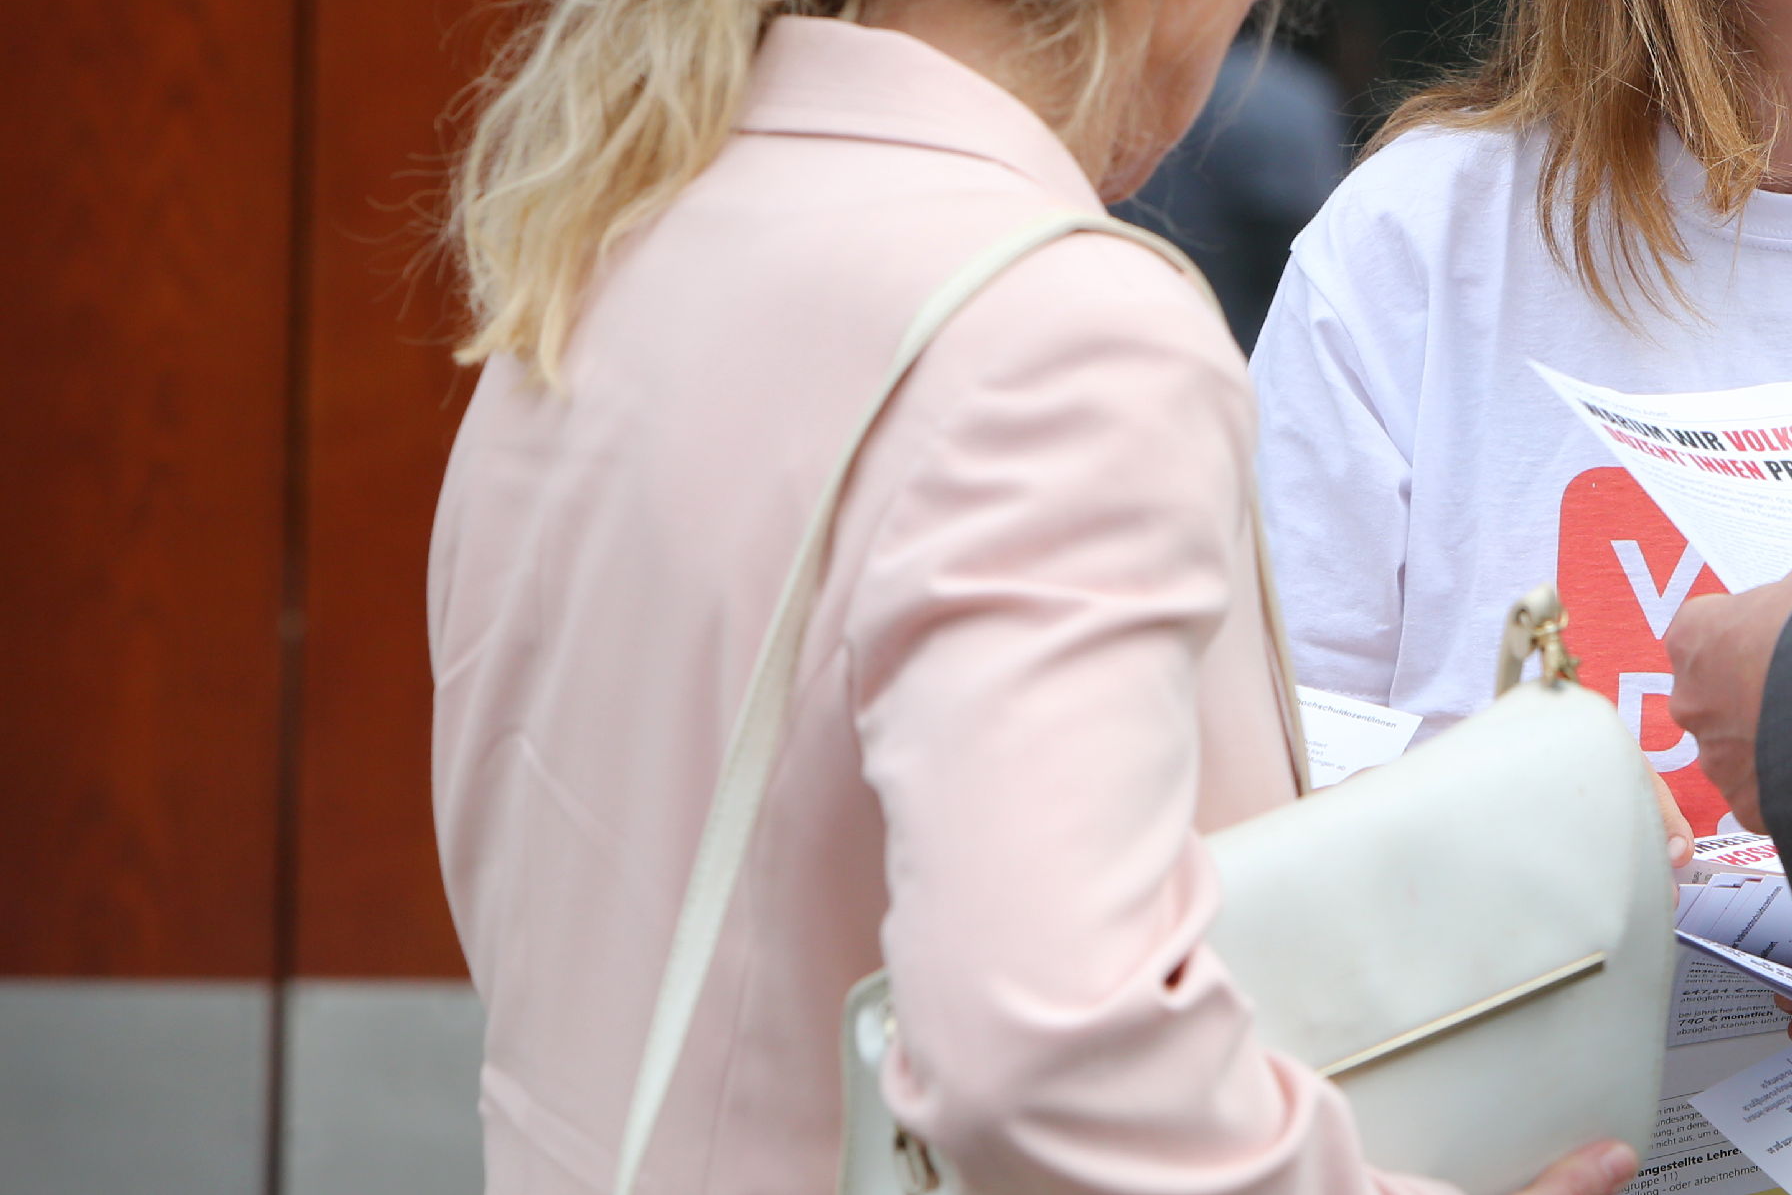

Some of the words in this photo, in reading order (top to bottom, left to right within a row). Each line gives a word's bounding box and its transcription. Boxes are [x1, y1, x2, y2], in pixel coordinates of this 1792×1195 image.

[1665, 428, 1728, 452] WIR
[1610, 540, 1707, 641] V
[1678, 1016, 1704, 1027] 790
[1708, 1015, 1719, 1023] €
[1720, 1010, 1774, 1022] monatlich
[1761, 1016, 1778, 1025] und
[1663, 1105, 1675, 1115] im
[1676, 1125, 1685, 1133] in
[1656, 1137, 1677, 1150] nicht
[1697, 1130, 1712, 1140] um
[1637, 1155, 1704, 1178] angestellte
[1662, 1170, 1679, 1183] 11)
[1669, 1180, 1696, 1193] oder
